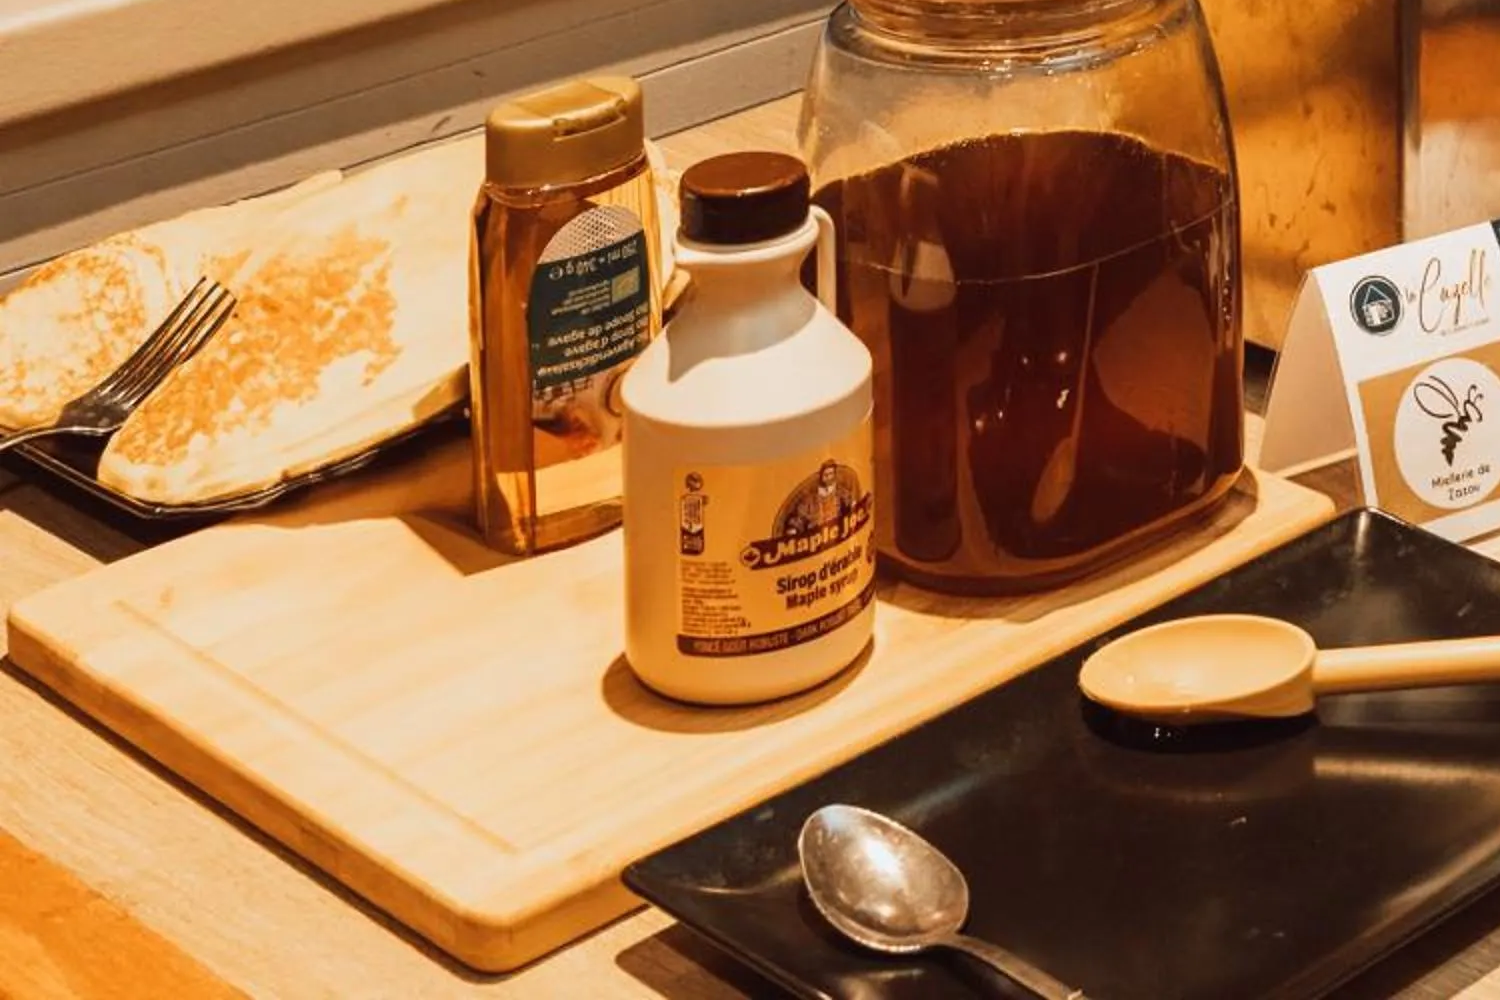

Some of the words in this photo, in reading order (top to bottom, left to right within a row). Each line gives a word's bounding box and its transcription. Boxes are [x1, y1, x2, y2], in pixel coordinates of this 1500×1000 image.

[1431, 469, 1474, 489] Miellerie
[1477, 464, 1491, 475] de
[763, 525, 840, 564] Maple
[776, 570, 817, 595] Sirop
[786, 585, 827, 610] Maple
